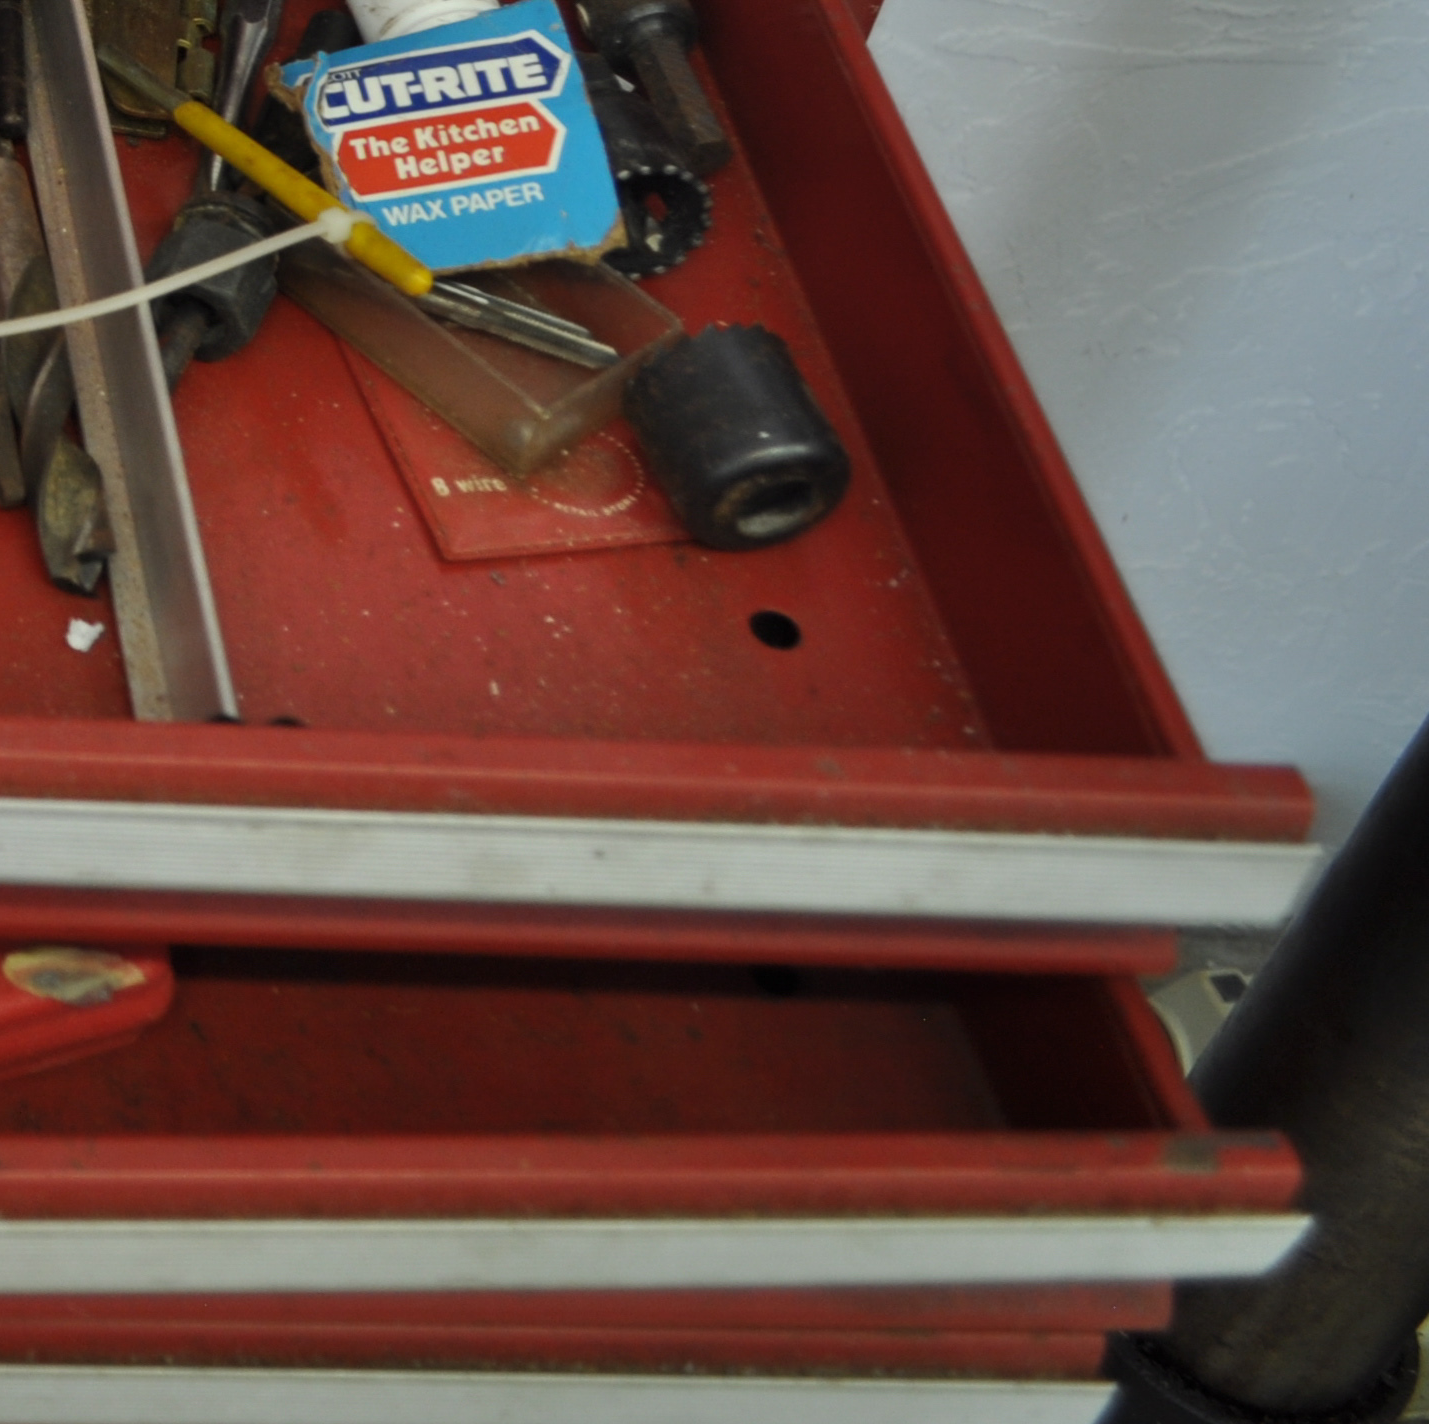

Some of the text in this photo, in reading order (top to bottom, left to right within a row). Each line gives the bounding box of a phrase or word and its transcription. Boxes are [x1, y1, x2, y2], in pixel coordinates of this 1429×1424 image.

[321, 52, 549, 119] CUT-RITE
[349, 114, 541, 162] The Kitchen
[394, 144, 506, 180] Helper
[381, 181, 546, 227] WAX PAPER
[454, 475, 508, 494] wire
